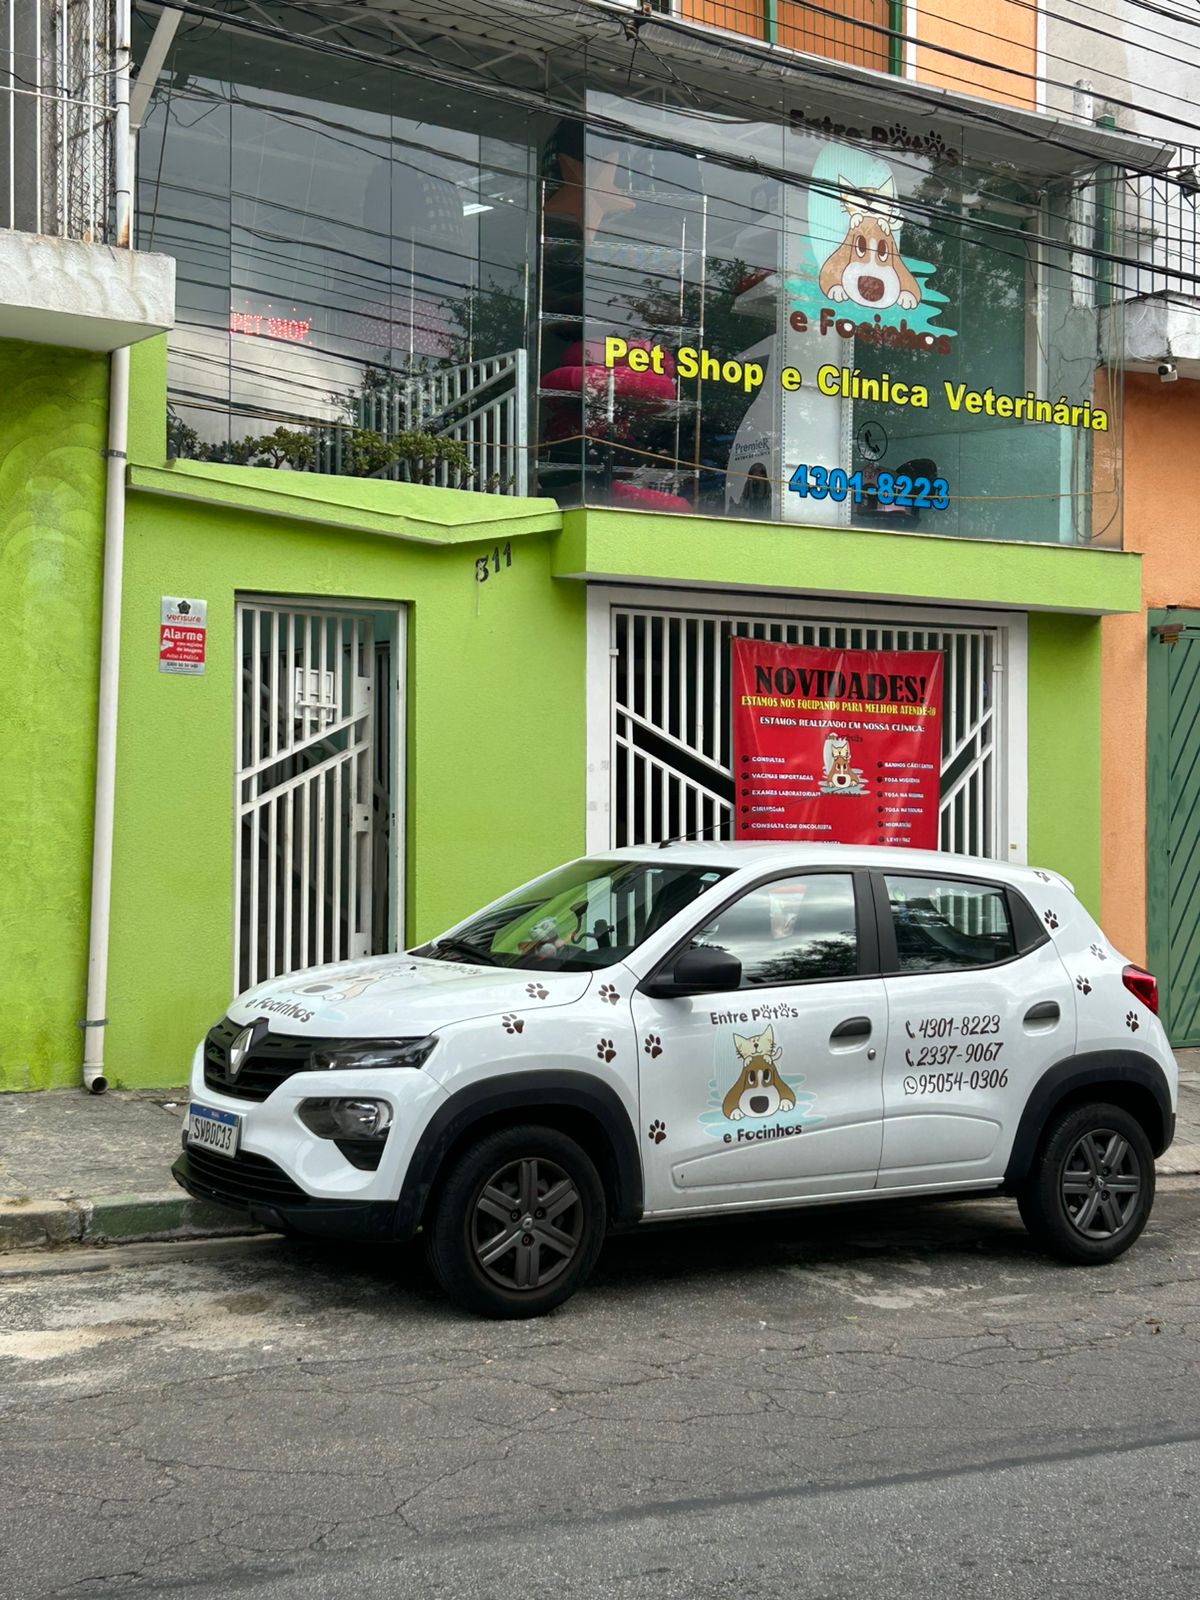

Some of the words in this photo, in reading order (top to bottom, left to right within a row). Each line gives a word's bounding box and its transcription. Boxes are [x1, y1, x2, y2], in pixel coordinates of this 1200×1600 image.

[232, 312, 262, 334] PET
[266, 317, 309, 341] SHOP
[789, 310, 808, 333] e
[819, 308, 951, 356] Focinhos
[604, 336, 665, 375] Pet
[676, 347, 765, 393] Shop
[781, 366, 802, 391] e
[816, 364, 929, 408] Clínica
[943, 380, 1109, 431] Veterinária
[788, 464, 950, 510] 4301-8223
[163, 628, 203, 641] Alarme
[755, 665, 927, 704] NOVIDADES!
[741, 695, 778, 707] ESTAMOS
[780, 698, 795, 708] NOS
[797, 700, 839, 711] EQUIPANDO
[841, 702, 863, 712] PARA
[865, 703, 898, 714] MELHOR
[760, 716, 797, 726] ESTAMOS
[799, 718, 847, 729] REALIZANDO
[848, 721, 861, 729] EM
[862, 722, 890, 731] NOSSA
[254, 997, 315, 1023] Focinhos
[710, 1010, 748, 1025] Entre
[918, 1014, 1001, 1039] 4301-8223
[916, 1041, 1004, 1067] 2337-9067
[919, 1068, 1009, 1095] 95054-0306
[723, 1133, 732, 1144] e
[737, 1123, 802, 1142] Focinhos
